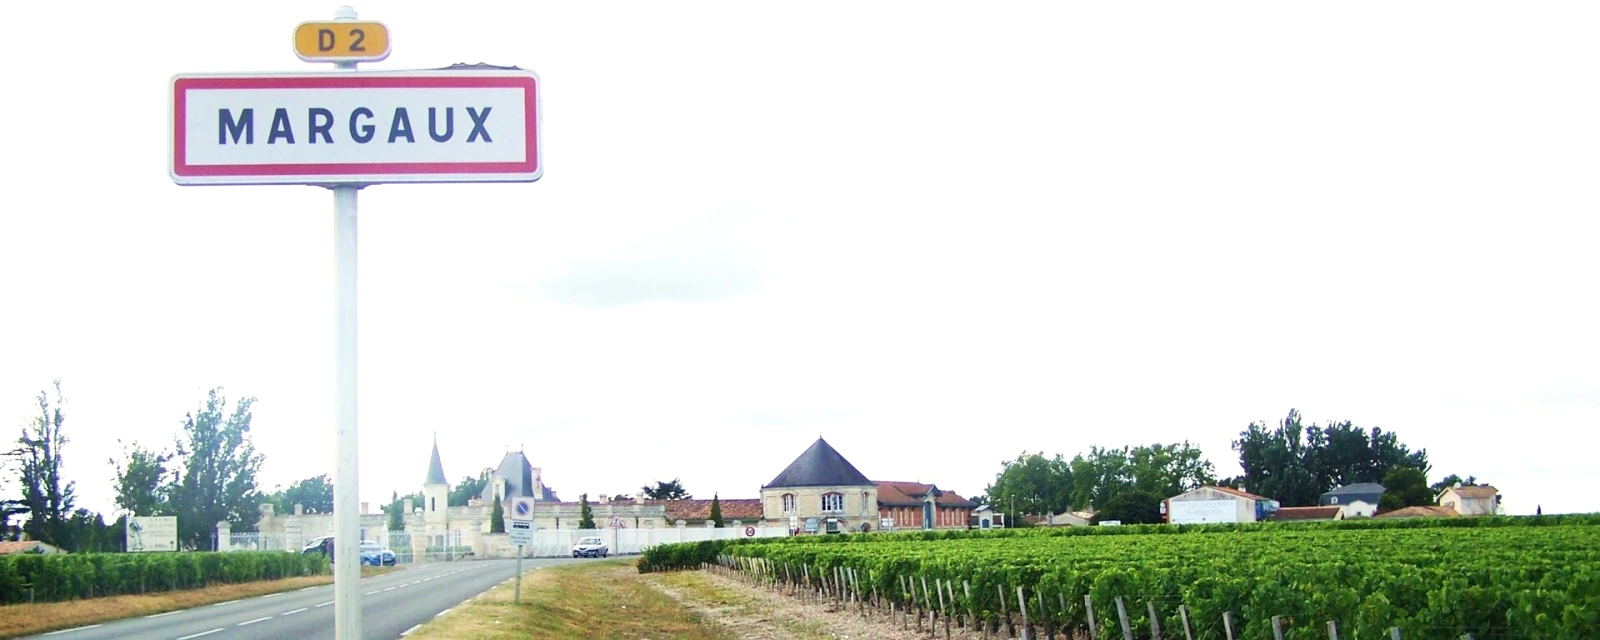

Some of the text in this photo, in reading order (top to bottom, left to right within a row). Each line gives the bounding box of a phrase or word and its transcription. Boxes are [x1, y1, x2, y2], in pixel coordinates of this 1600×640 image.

[318, 29, 366, 52] D 2
[218, 106, 493, 145] MARGAUX
